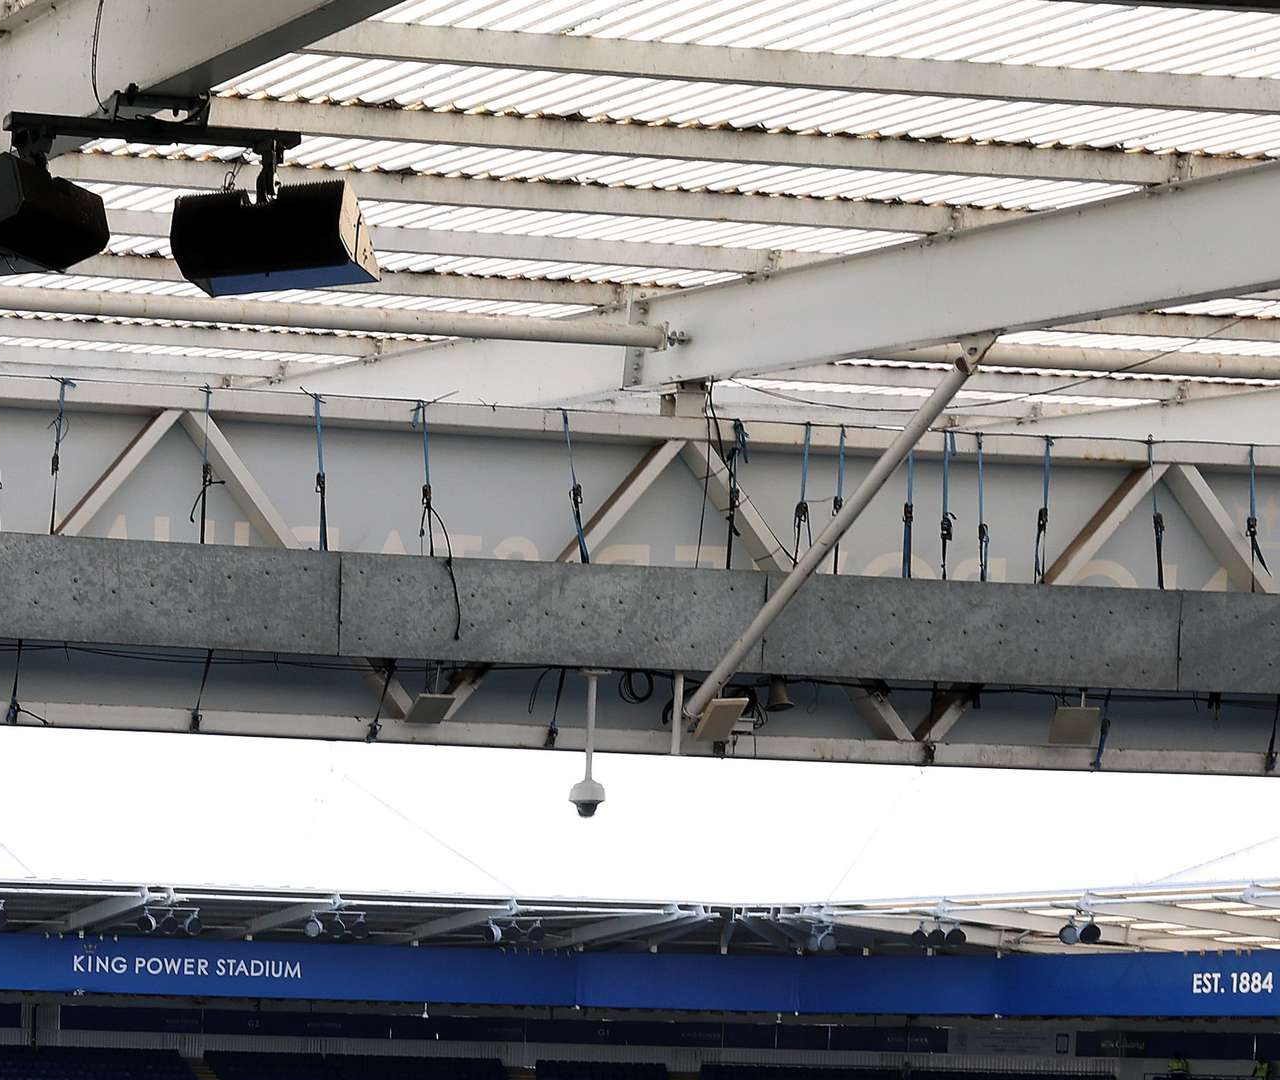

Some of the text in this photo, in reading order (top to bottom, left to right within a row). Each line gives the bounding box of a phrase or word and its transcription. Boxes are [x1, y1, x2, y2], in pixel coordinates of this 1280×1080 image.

[74, 955, 301, 978] KING POWER STADIUM
[1193, 972, 1273, 993] EST. 1884
